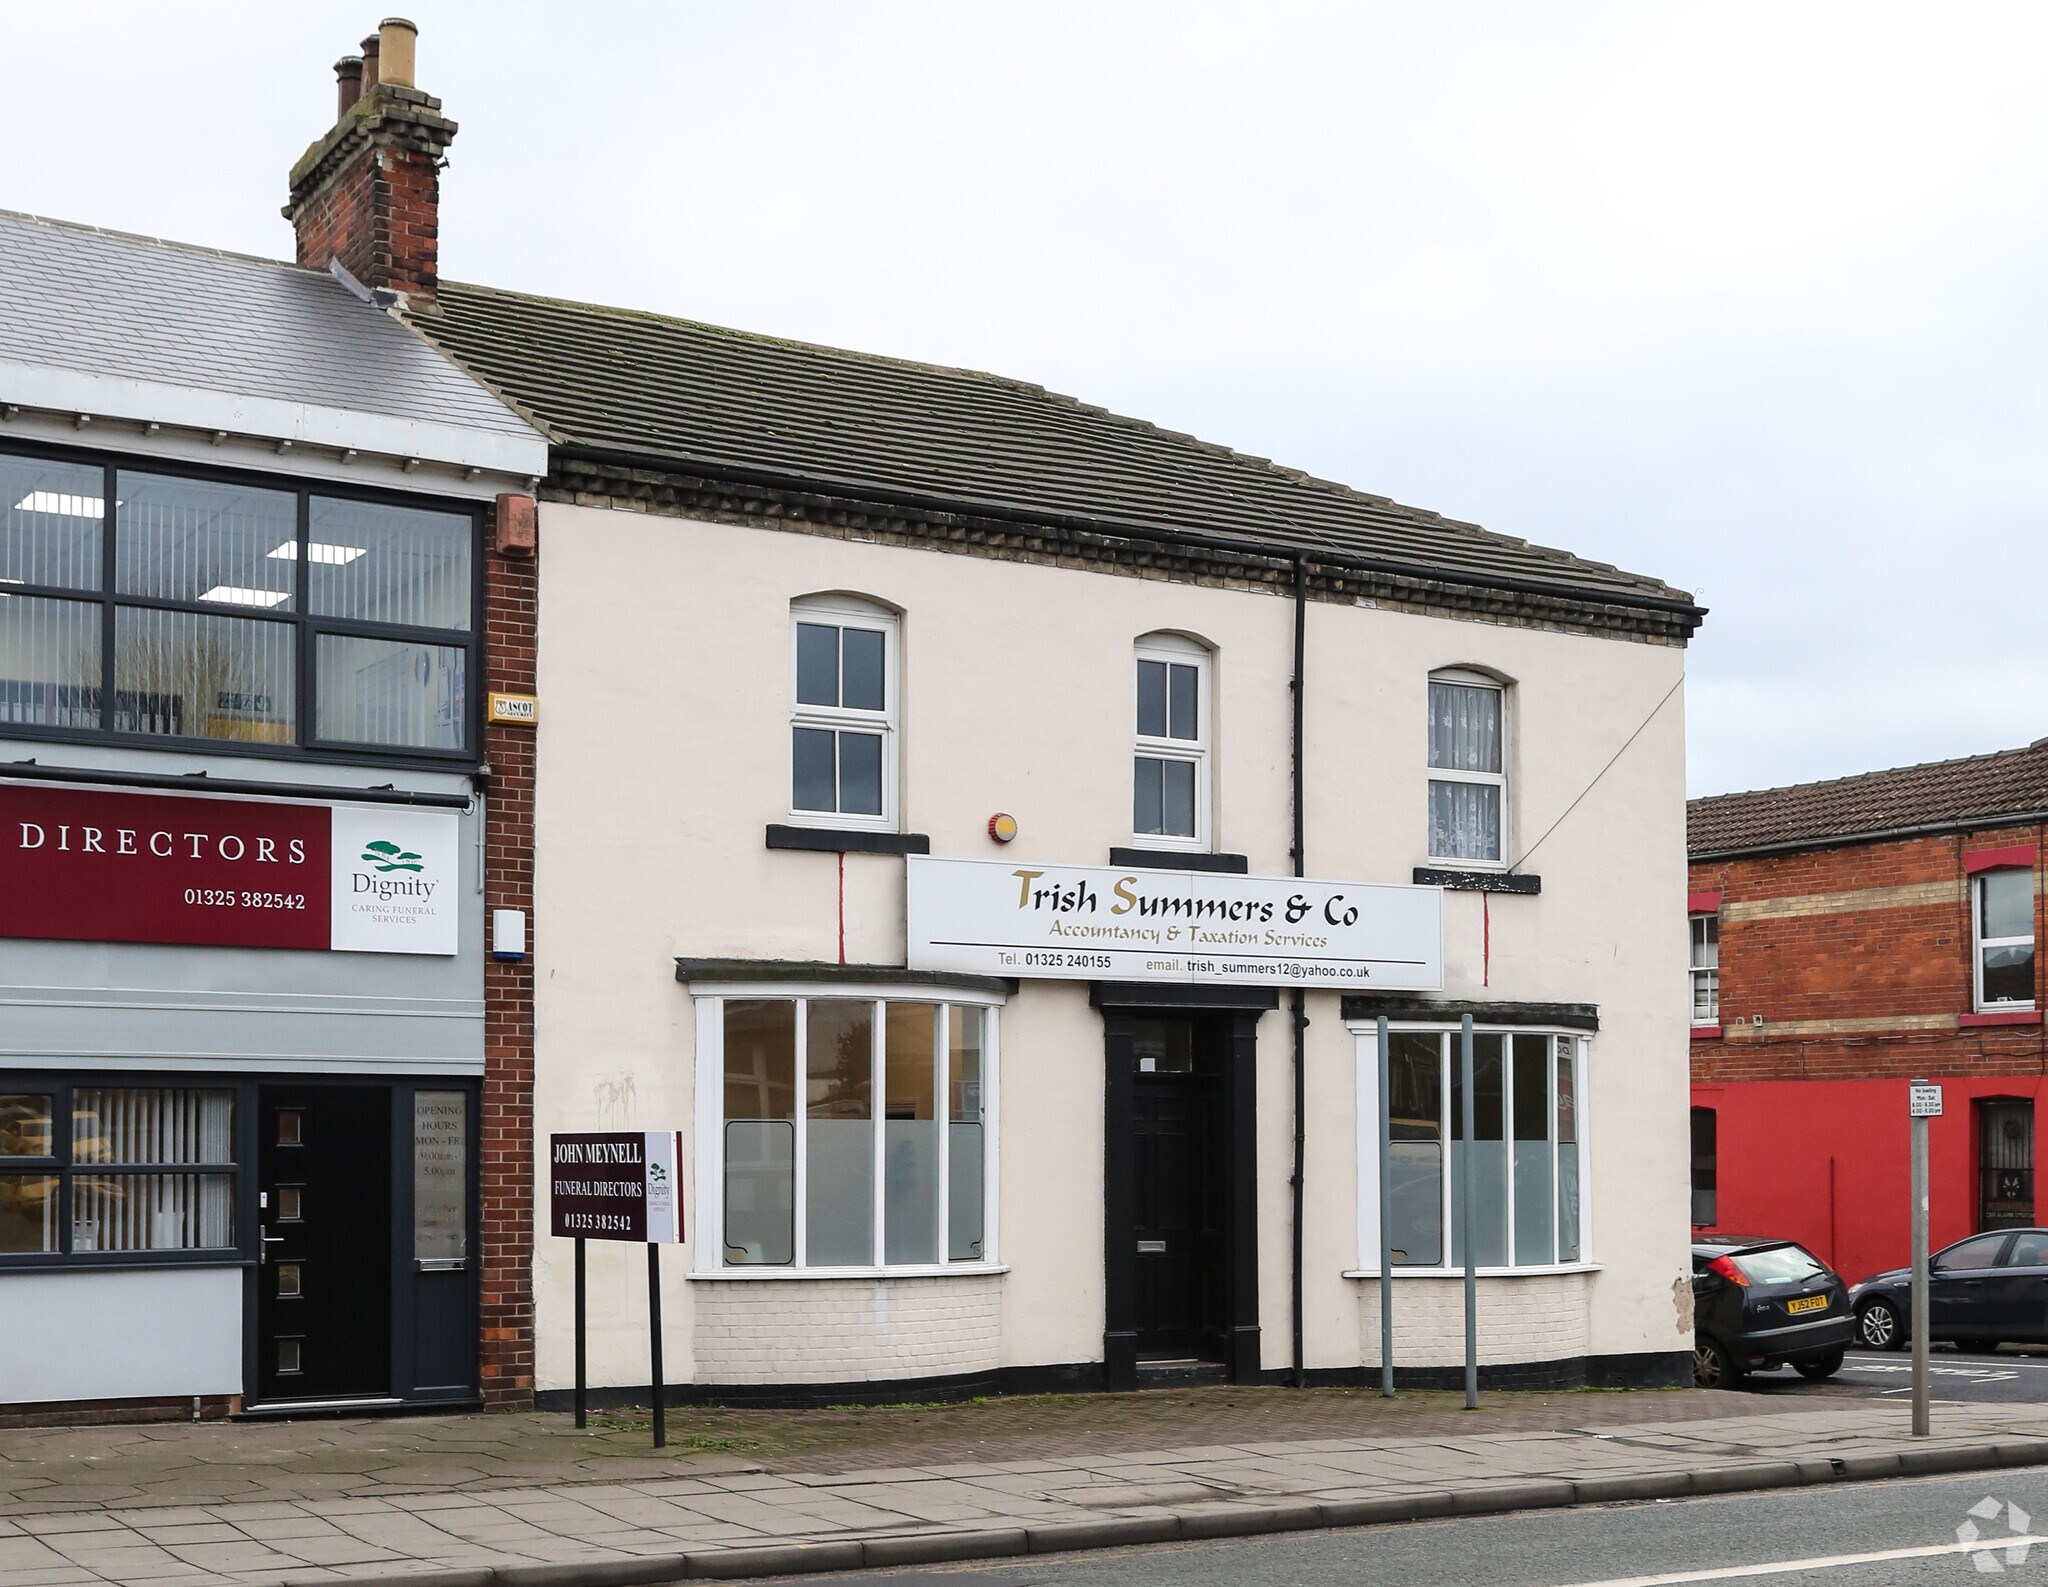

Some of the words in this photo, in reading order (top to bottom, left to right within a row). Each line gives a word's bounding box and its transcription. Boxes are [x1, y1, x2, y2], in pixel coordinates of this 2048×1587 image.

[508, 701, 533, 713] ASCOT
[19, 822, 306, 865] DIRECTORS
[352, 873, 435, 903] Dignity
[183, 888, 236, 907] 01325
[241, 891, 305, 910] 382542
[1012, 869, 1096, 913] Trish
[1110, 876, 1273, 922] Summers
[1284, 894, 1312, 924] &
[1324, 894, 1359, 926] Co
[352, 904, 389, 914] CARING
[392, 906, 436, 916] FUNERAL
[372, 914, 416, 924] SERVICES
[1049, 919, 1160, 944] Accountancy
[1167, 925, 1182, 941] &
[1189, 925, 1258, 945] Taxation
[1264, 929, 1328, 948] Services
[998, 953, 1021, 965] Tel.
[1025, 953, 1063, 967] 01325
[1067, 954, 1111, 969] 240155
[1187, 960, 1370, 978] trish_summers12@yahoo.co.uk
[416, 1106, 463, 1116] OPENING
[422, 1121, 457, 1130] HOURS
[416, 1136, 440, 1145] MON
[554, 1143, 583, 1163] JOHN
[585, 1143, 642, 1163] MEYNELL
[555, 1180, 592, 1196] FUNERAL
[593, 1181, 642, 1197] DIRECTORS
[564, 1213, 593, 1228] 01325
[595, 1214, 631, 1230] 382542
